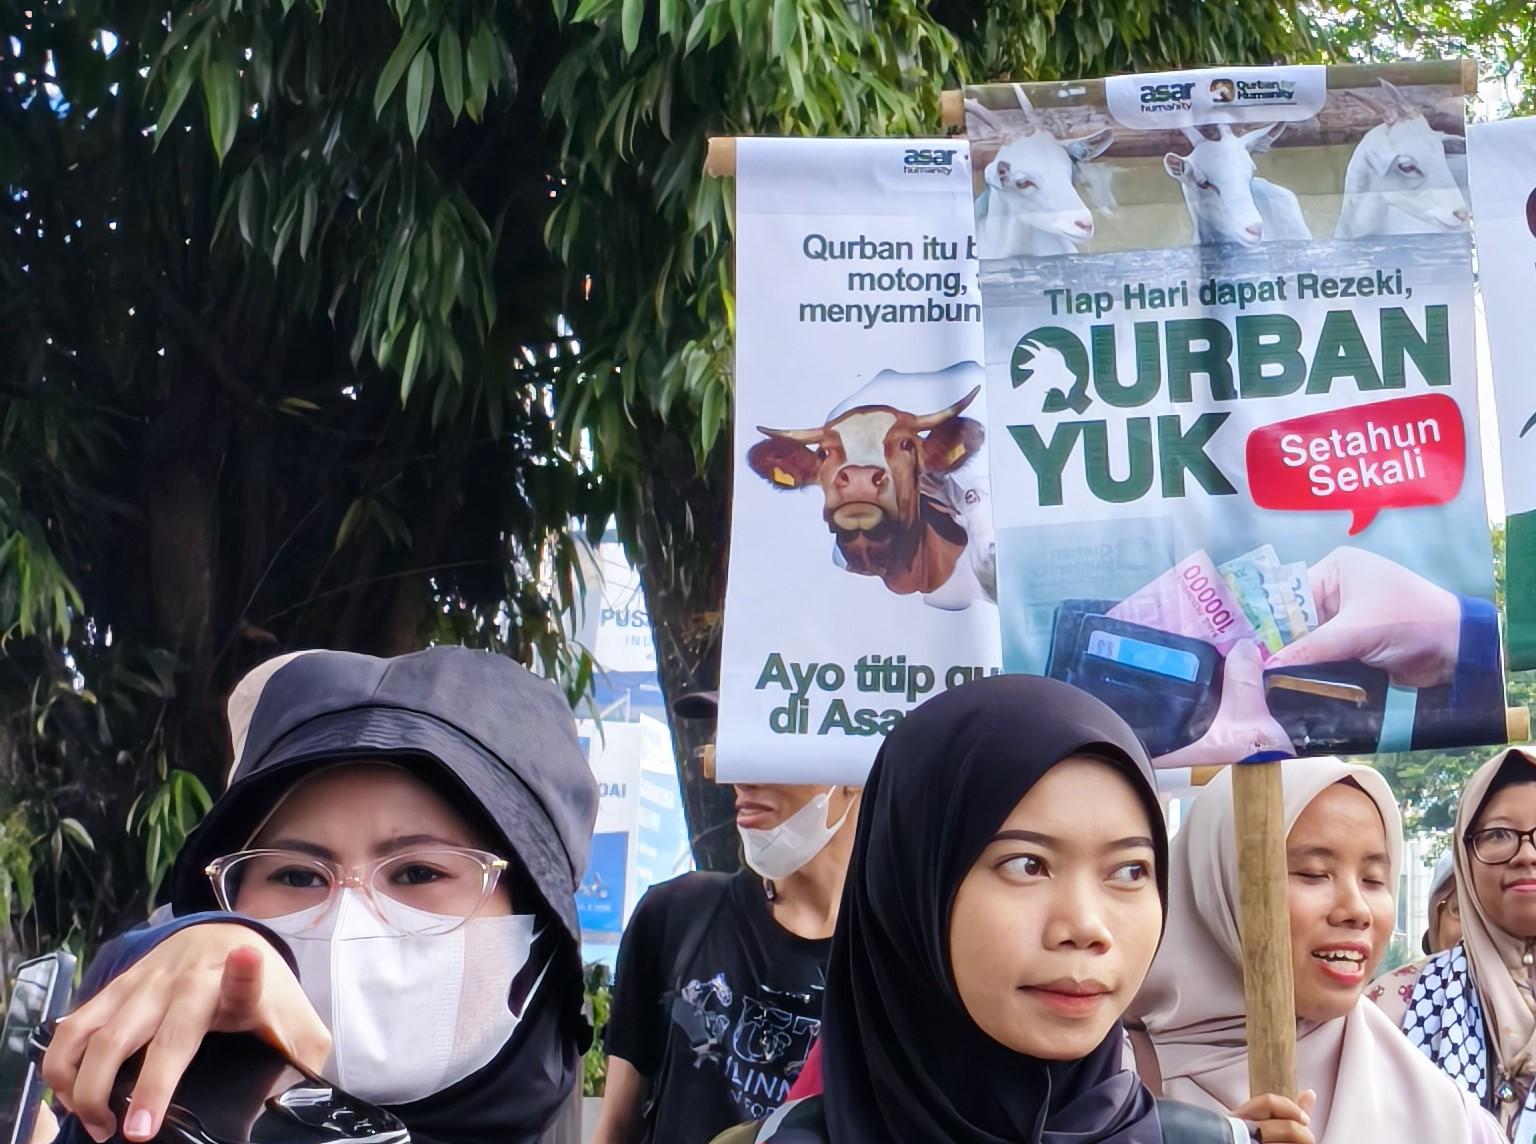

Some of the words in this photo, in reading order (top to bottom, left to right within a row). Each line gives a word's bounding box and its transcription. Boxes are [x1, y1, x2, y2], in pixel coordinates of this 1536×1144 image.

[1140, 82, 1195, 103] asar
[1141, 102, 1192, 113] humanity
[903, 149, 957, 166] asar
[903, 165, 952, 176] humanity
[803, 234, 914, 260] Qurban
[923, 236, 958, 260] itu
[848, 267, 968, 297] motong,
[1124, 279, 1188, 310] Hari
[1198, 275, 1286, 310] dapat
[1297, 268, 1413, 300] Rezeki,
[1010, 305, 1451, 415] QURBAN
[1006, 411, 1238, 507] YUK
[1281, 417, 1441, 468] Setahun
[1308, 453, 1426, 498] Sekali
[755, 652, 846, 697] Ayo
[854, 655, 936, 702] titip
[769, 693, 809, 734] di
[817, 699, 909, 736] Asa
